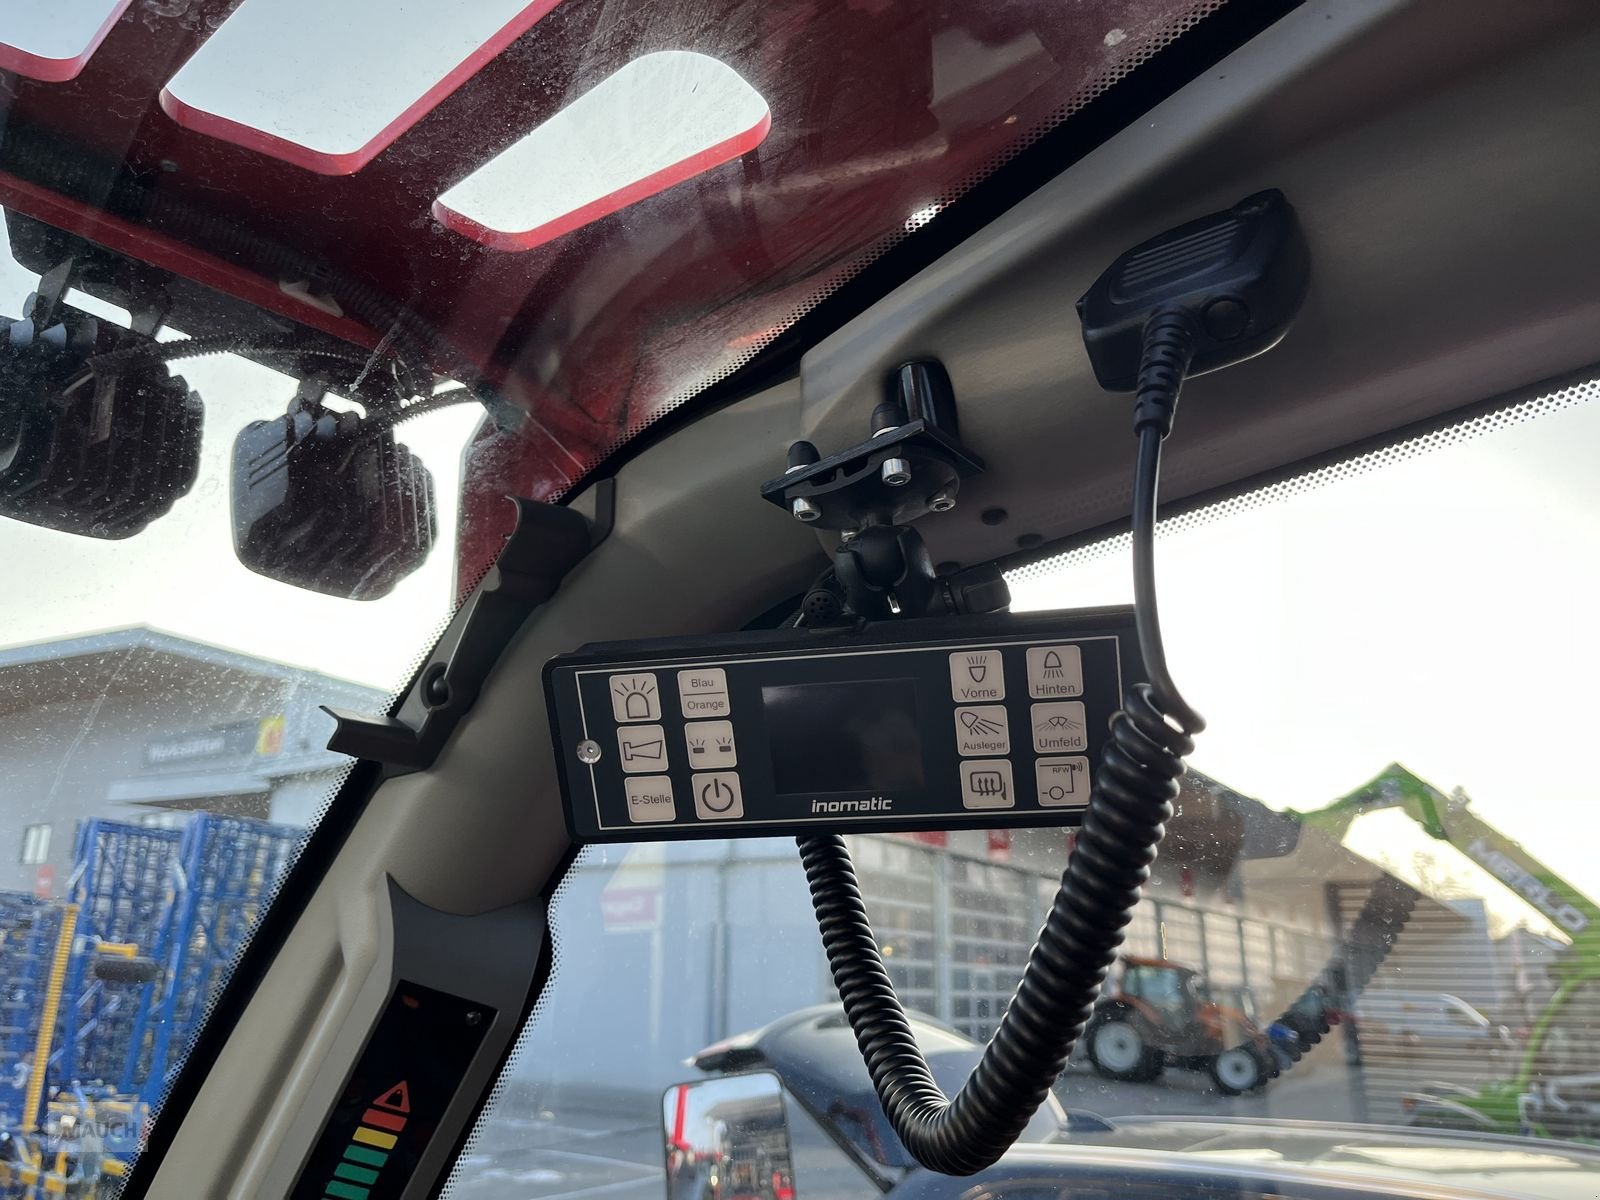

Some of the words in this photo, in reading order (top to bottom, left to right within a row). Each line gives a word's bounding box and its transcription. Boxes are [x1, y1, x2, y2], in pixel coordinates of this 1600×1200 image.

[691, 677, 714, 689] Blau
[961, 687, 997, 699] Vorne
[1036, 684, 1075, 695] Hinten
[687, 699, 725, 712] Orange
[963, 741, 1006, 751] Ausleger
[1039, 736, 1081, 748] Umfeld
[1052, 766, 1070, 774] RFW
[631, 793, 672, 806] E-Stelle
[811, 796, 893, 814] inomatic
